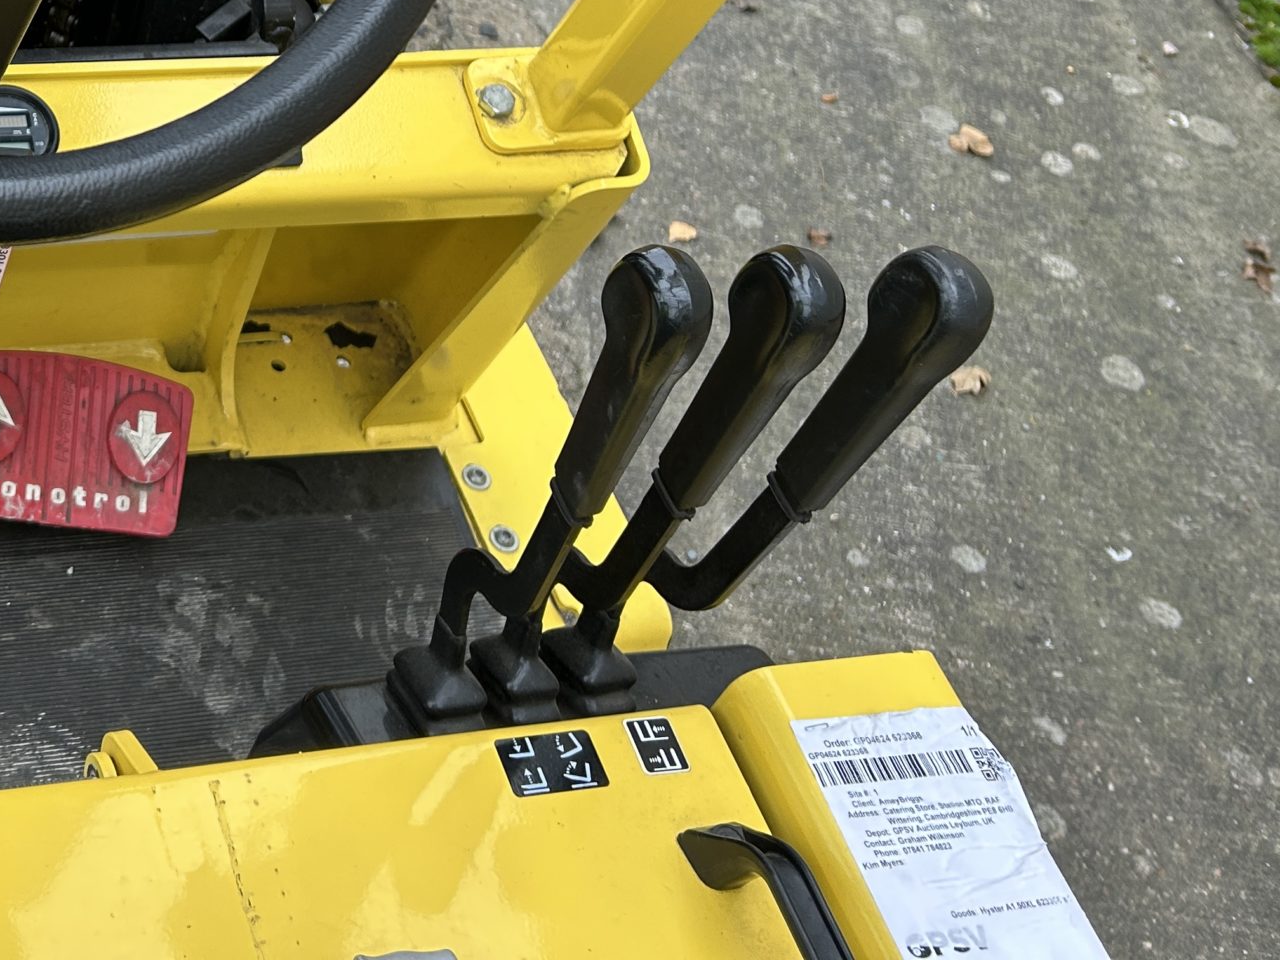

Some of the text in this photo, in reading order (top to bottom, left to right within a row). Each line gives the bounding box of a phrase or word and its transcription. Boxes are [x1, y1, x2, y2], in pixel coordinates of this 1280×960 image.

[960, 724, 978, 738] 1/1
[823, 738, 851, 749] Order:
[882, 806, 916, 815] Catering
[923, 808, 982, 821] Cambridgeshire
[892, 825, 914, 835] GPSV
[916, 823, 949, 832] Auctions
[981, 817, 996, 825] UK
[897, 835, 928, 845] Graham
[862, 862, 880, 870] Kim
[979, 905, 1005, 916] Hyster
